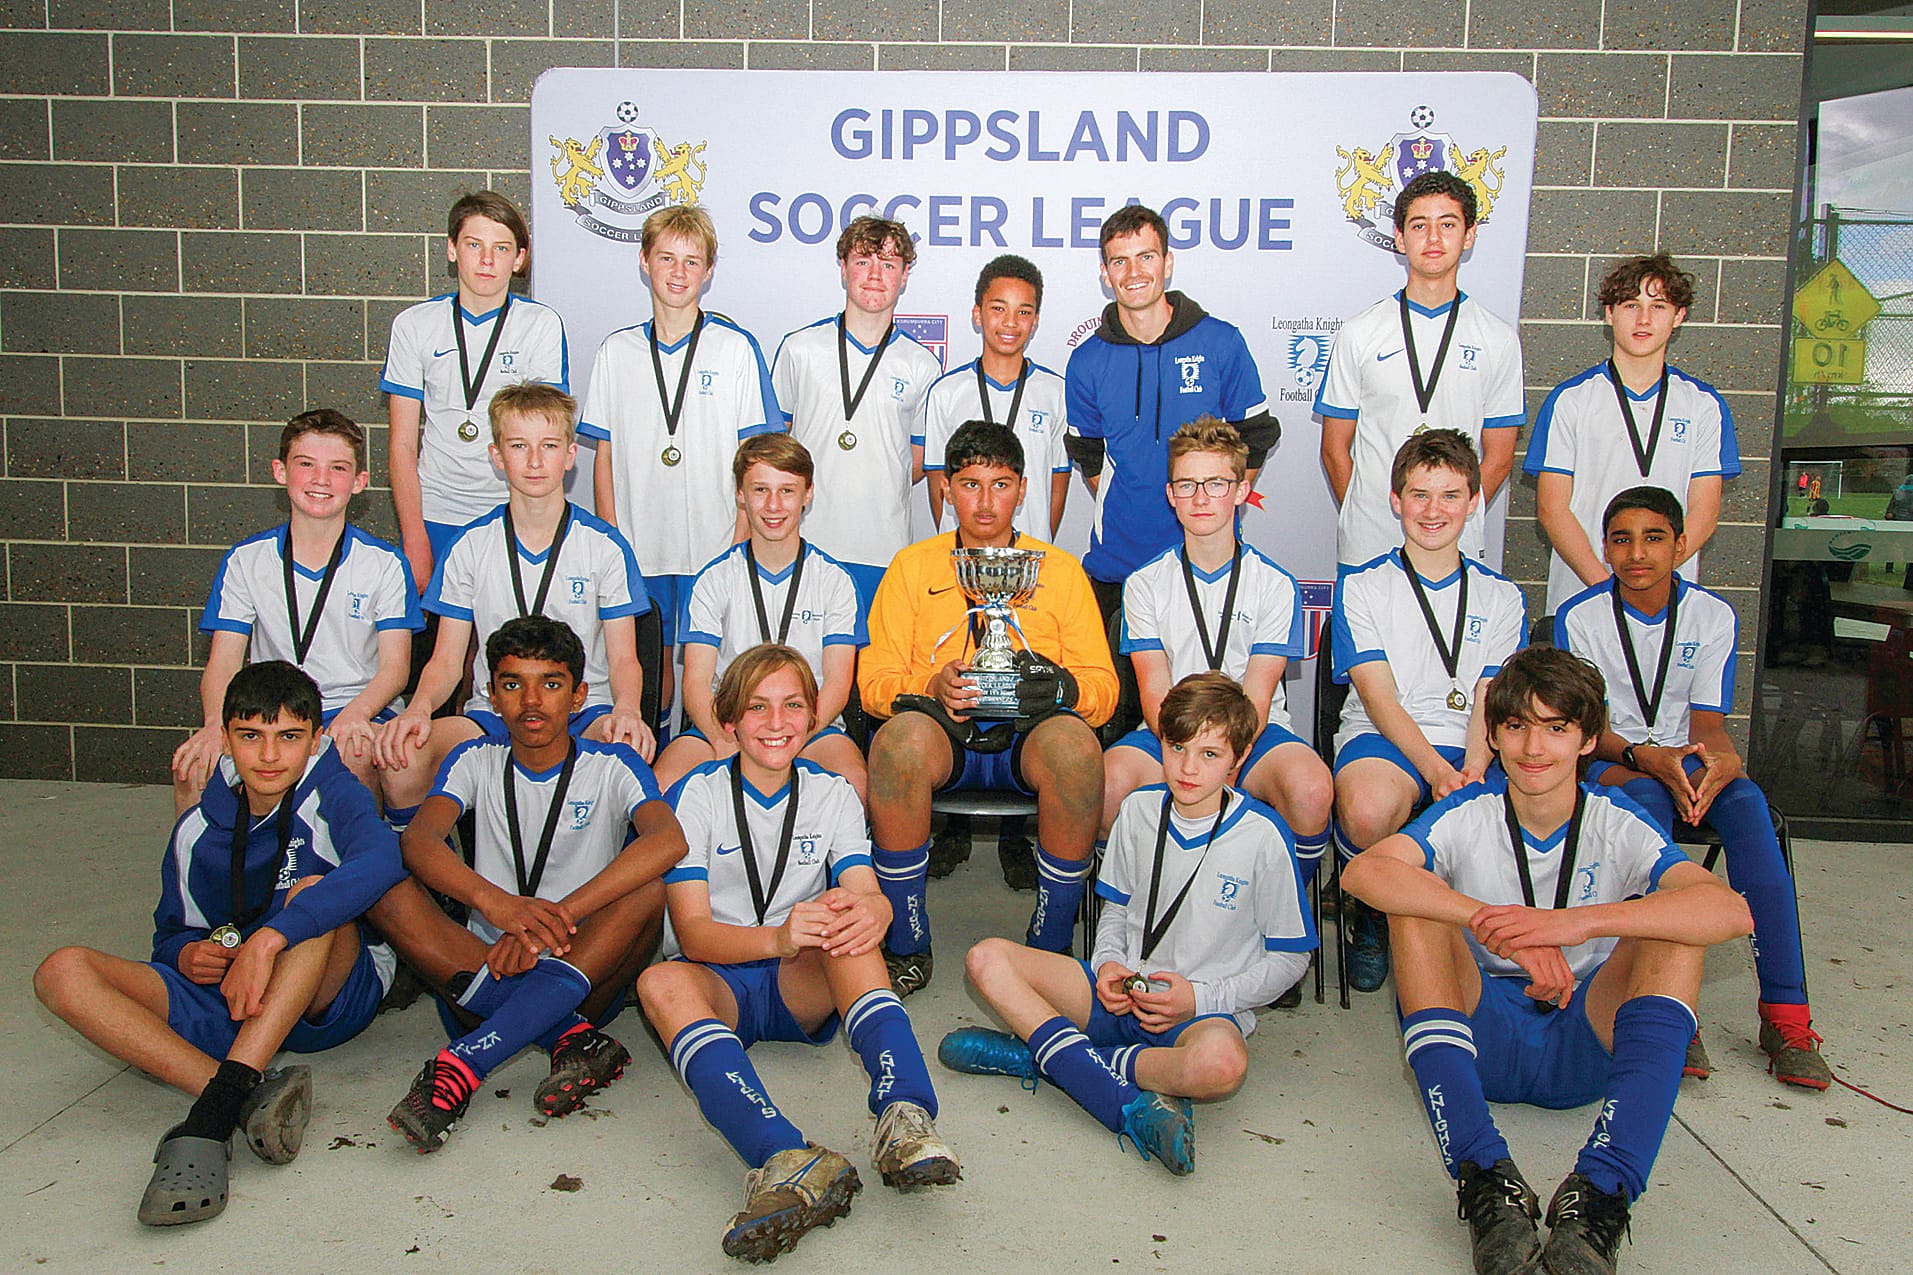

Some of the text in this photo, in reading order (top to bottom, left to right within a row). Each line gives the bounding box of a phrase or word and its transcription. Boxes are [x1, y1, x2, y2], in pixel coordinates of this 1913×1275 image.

[831, 108, 1210, 162] GIPPSLAND
[599, 196, 663, 213] GIPPSLAND
[584, 218, 629, 240] SOCCER
[1031, 197, 1294, 250] LEGUE
[1272, 316, 1343, 334] Leongatha Knight
[1280, 388, 1313, 402] Football
